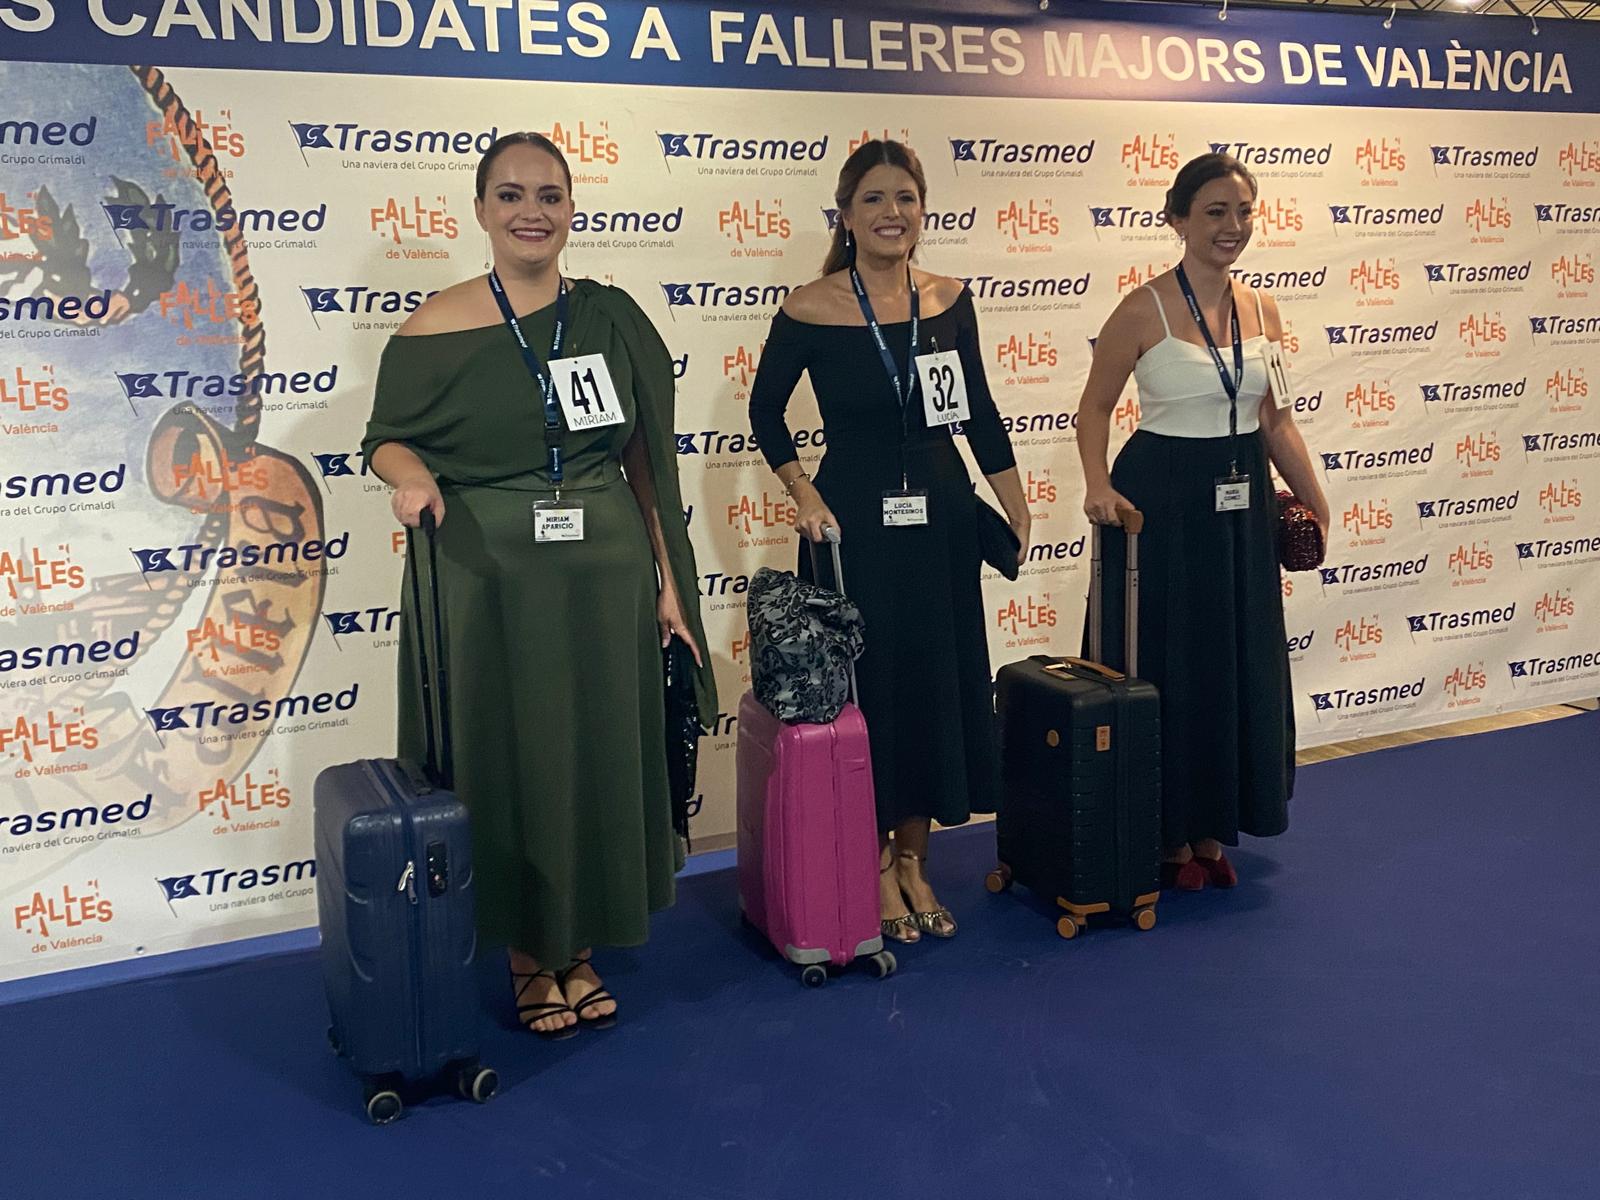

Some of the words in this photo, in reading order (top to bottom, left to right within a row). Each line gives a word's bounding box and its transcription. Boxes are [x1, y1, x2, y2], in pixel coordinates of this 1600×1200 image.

[87, 0, 610, 58] CANDIDATES
[630, 6, 680, 61] A
[709, 9, 1026, 77] FALLERES
[1044, 29, 1266, 84] MAJORS
[1279, 41, 1347, 86] DE
[1356, 40, 1572, 93] VALÈNCIA
[334, 122, 498, 155] Trasmed
[552, 120, 619, 165] ALLES
[693, 134, 828, 160] Trasmed
[980, 140, 1094, 163] Trasmed
[342, 160, 360, 168] Una
[363, 160, 398, 169] naviera
[400, 161, 415, 169] del
[418, 162, 445, 171] Grupo
[448, 161, 479, 171] Grimal
[1122, 134, 1178, 173] FALLES
[1234, 143, 1331, 167] Trasmed
[1356, 138, 1405, 174] FALLES
[1453, 146, 1538, 166] Trasmed
[1559, 142, 1600, 176] FALLES
[698, 167, 713, 175] Una
[715, 167, 744, 175] naviera
[760, 168, 783, 176] Grupo
[785, 168, 817, 176] Grimaldi
[1022, 168, 1034, 177] del
[1032, 168, 1054, 178] Grupo
[1055, 169, 1083, 177] Grimaldi
[150, 204, 326, 232] Trasmed
[371, 196, 458, 244] FALLES
[570, 207, 683, 233] asmed
[719, 199, 790, 243] FALLES
[998, 199, 1059, 240] FALLES
[1117, 205, 1168, 227] Tras
[1353, 204, 1443, 224] Trasmed
[1466, 197, 1511, 232] FALLES
[1555, 204, 1600, 222] Tras
[386, 249, 400, 259] de
[402, 249, 449, 259] València
[612, 240, 637, 248] Grupo
[639, 240, 674, 248] Grimaldi
[731, 248, 742, 257] de
[744, 248, 783, 257] València
[977, 273, 1090, 298] Trasmed
[1230, 267, 1326, 288] Trasmed
[1350, 259, 1399, 294] FALLES
[1447, 261, 1531, 282] Trasmed
[1552, 254, 1594, 288] FALLES
[0, 290, 111, 320] smed
[346, 286, 422, 314] Tras
[697, 282, 800, 306] Trasm
[1349, 321, 1438, 344] Trasmed
[1460, 312, 1506, 347] FALLES
[1549, 316, 1600, 334] Trasm
[998, 332, 1057, 373] FALLES
[0, 365, 68, 413] LLES
[164, 365, 338, 397] Trasmed
[570, 368, 605, 415] 41
[929, 365, 958, 412] 32
[1005, 377, 1015, 385] de
[1443, 378, 1526, 401] Trasmed
[1546, 368, 1587, 402] FALLES
[1346, 380, 1395, 417] FALLES
[573, 412, 617, 427] MIRIAM
[937, 413, 960, 423] LUCÍA
[1004, 411, 1077, 434] asme
[700, 428, 826, 454] Trased
[1457, 432, 1500, 467] FALLES
[1543, 433, 1600, 451] Trasme
[1344, 443, 1433, 469] Trasmed
[6, 464, 125, 498] smed
[1438, 491, 1519, 517] Trasmed
[1539, 479, 1581, 513] FALLES
[728, 491, 797, 535] FALLES
[1344, 499, 1392, 536] FALLES
[179, 533, 349, 571] Trasmed
[738, 539, 749, 548] de
[751, 536, 789, 546] València
[1536, 537, 1600, 558] Trasme
[0, 544, 85, 599] ALLES
[1341, 554, 1428, 583] Trasmed
[1449, 541, 1493, 576] FALLES
[998, 594, 1056, 635] FALLES
[1429, 603, 1515, 631] Trasmed
[1535, 588, 1574, 623] FALLES
[187, 609, 280, 662] FALLES
[1006, 640, 1016, 648] de
[1017, 636, 1049, 646] València
[1335, 615, 1382, 651] FALLES
[0, 631, 139, 673] asmed
[1334, 678, 1425, 708] Trasmed
[1444, 662, 1486, 697] FALLES
[189, 684, 359, 723] Trasmed
[0, 706, 98, 762] FALLES
[199, 735, 218, 744] Una
[222, 731, 256, 743] naviera
[277, 726, 306, 737] Grupo
[308, 719, 349, 733] Grimaldi
[15, 768, 31, 778] de
[34, 762, 88, 775] València
[199, 769, 290, 820] FALLES
[2, 842, 41, 854] naviera
[43, 837, 61, 847] del
[63, 835, 95, 844] Grupo
[96, 826, 140, 840] Grimaldi
[213, 826, 228, 834] de
[231, 818, 280, 832] València
[201, 860, 316, 895] Trasm
[15, 880, 113, 937] FALLES
[209, 903, 228, 911] Una
[231, 896, 266, 907] naviera
[268, 892, 284, 901] del
[286, 888, 314, 899] Grupo
[32, 944, 47, 953] de
[50, 934, 103, 949] València
